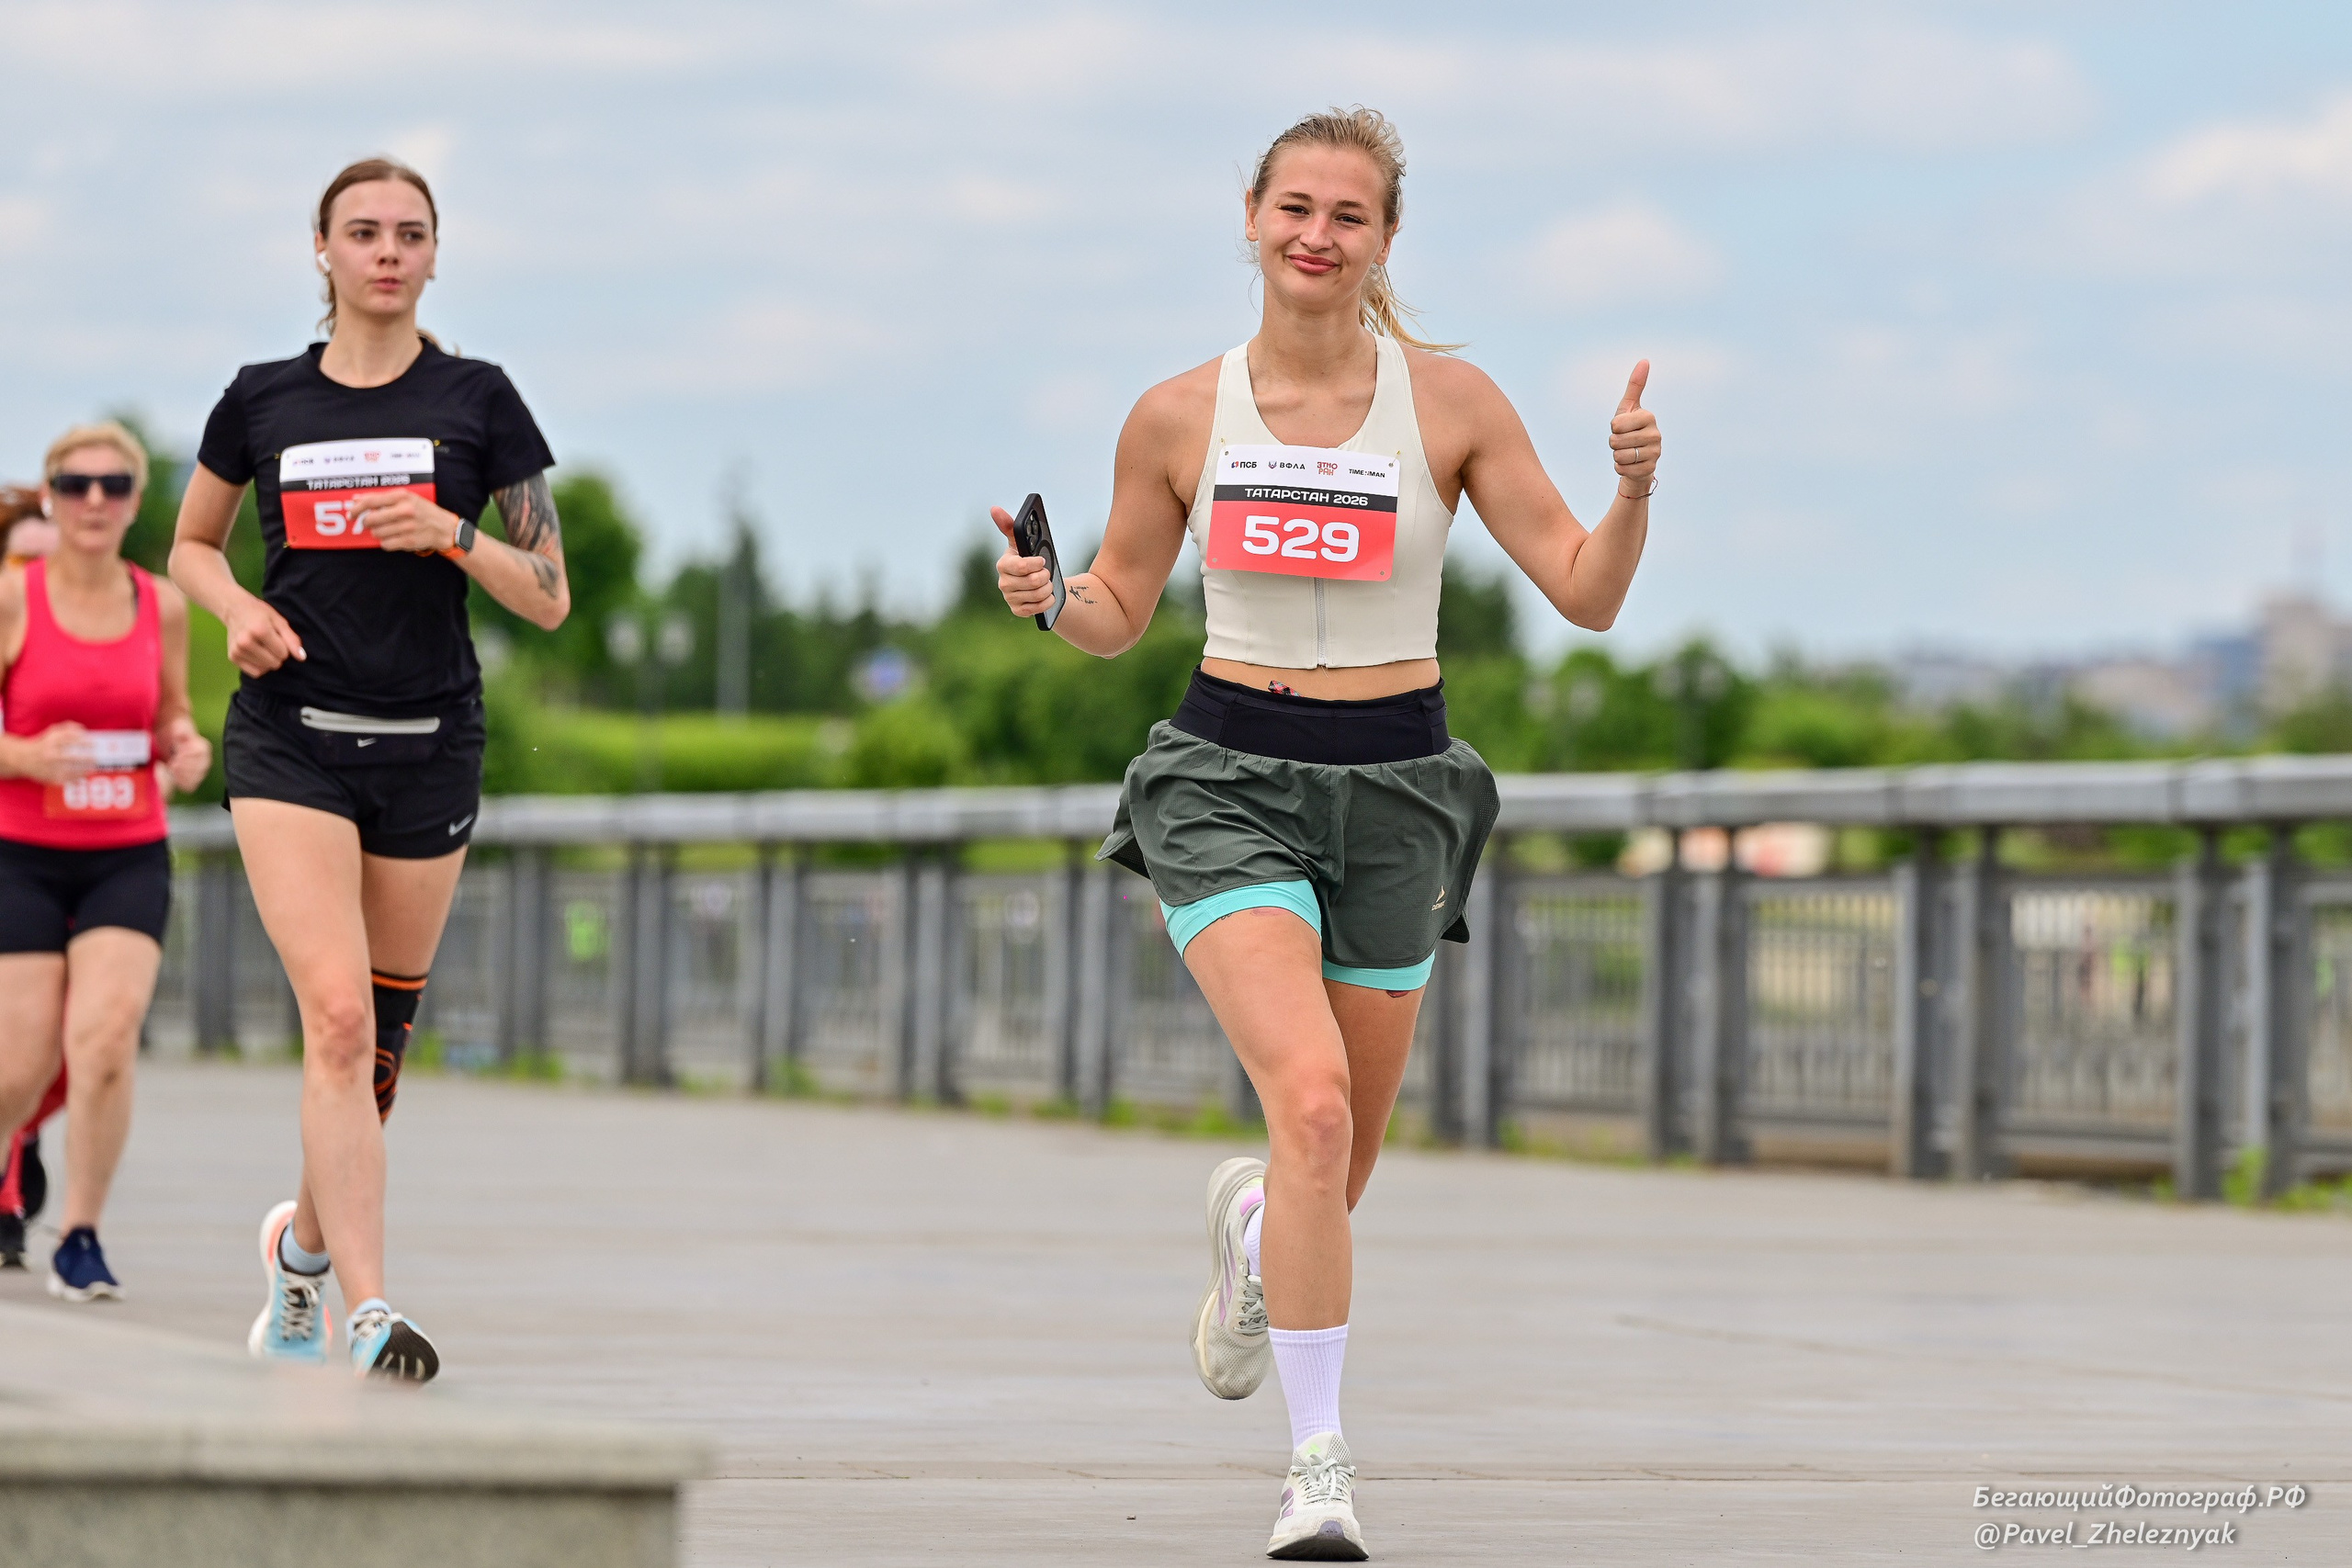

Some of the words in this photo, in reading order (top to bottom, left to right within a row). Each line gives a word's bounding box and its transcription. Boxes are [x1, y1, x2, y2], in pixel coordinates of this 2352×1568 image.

[1317, 461, 1338, 470] ЭТНО
[1244, 488, 1329, 502] ТАТАРСТАН
[1333, 494, 1368, 506] 2026
[1242, 515, 1360, 562] 529
